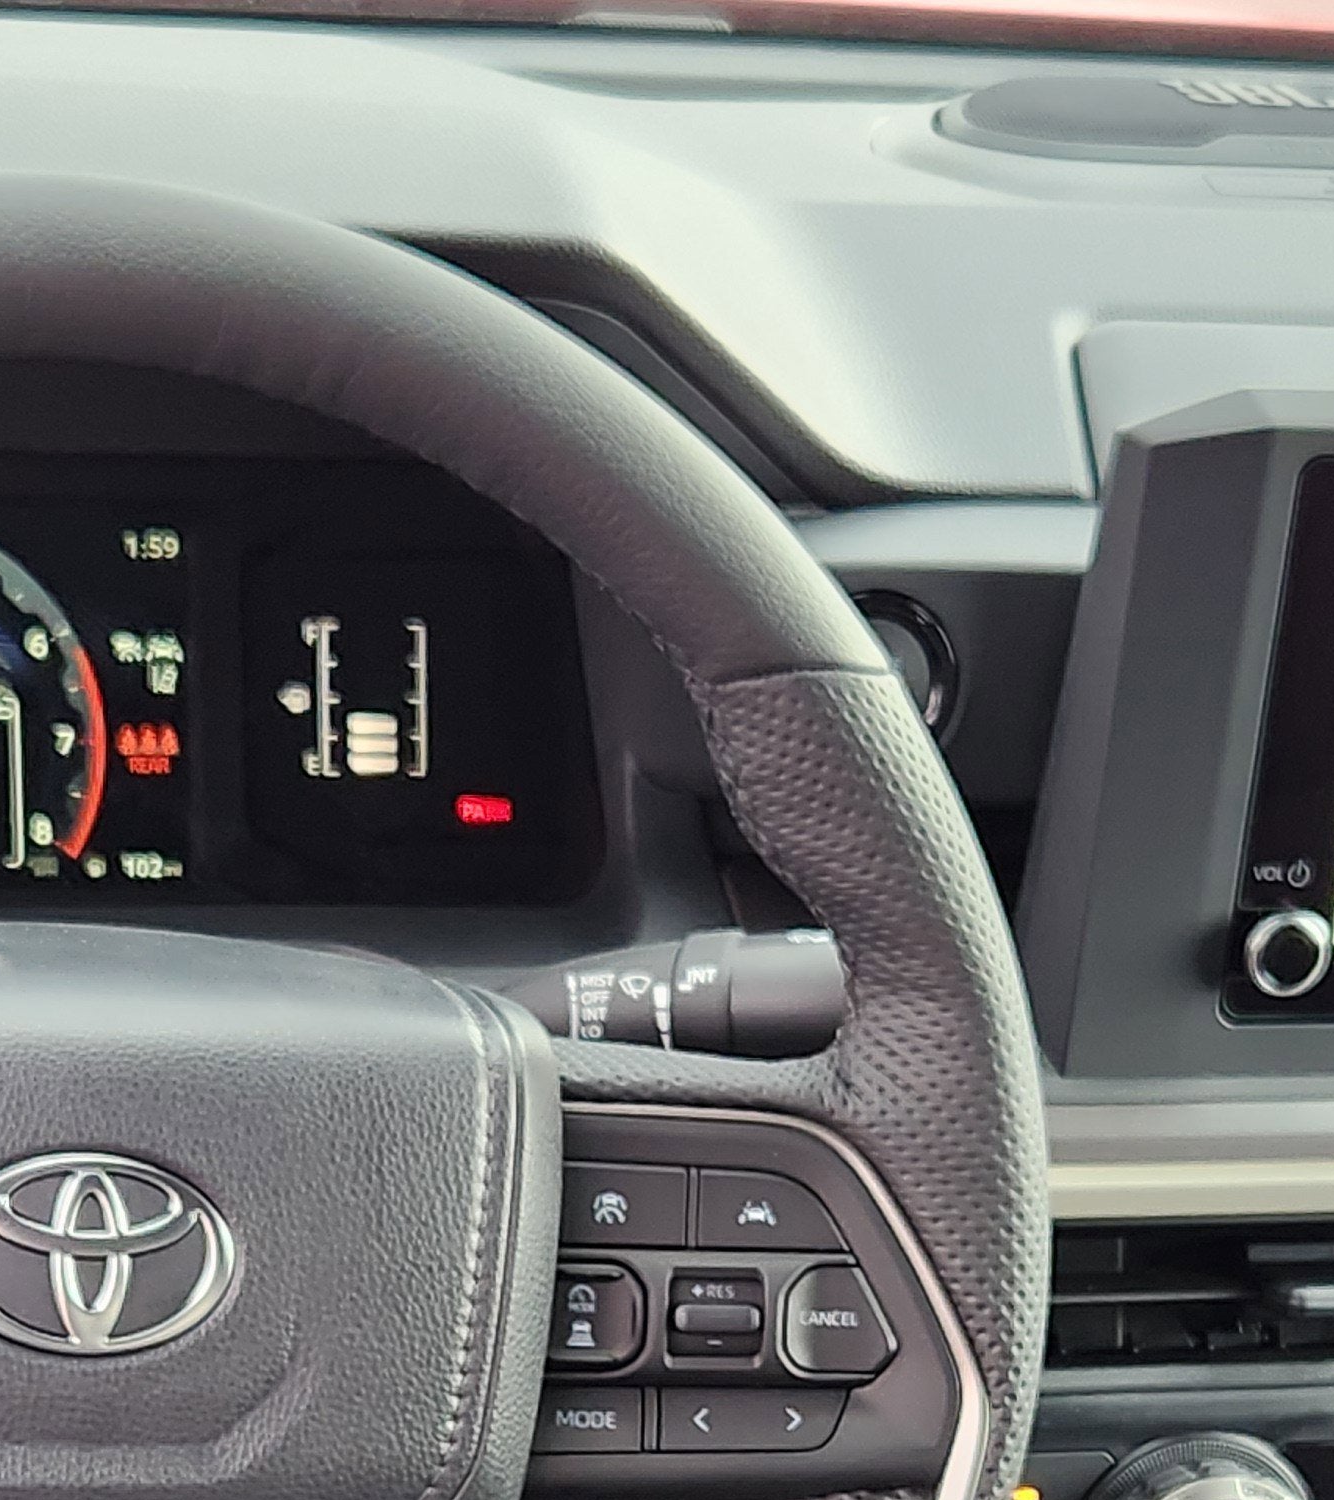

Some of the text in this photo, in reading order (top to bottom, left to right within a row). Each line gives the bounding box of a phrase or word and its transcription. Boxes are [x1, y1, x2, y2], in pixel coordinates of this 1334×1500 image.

[123, 529, 180, 560] 1:59
[23, 626, 49, 661] 6
[52, 721, 76, 757] 7
[28, 811, 54, 846] 8
[1252, 866, 1284, 882] VOL
[580, 973, 616, 989] MIST
[580, 990, 611, 1005] OFF
[580, 1006, 608, 1021] INT
[799, 1309, 859, 1328] CANCEL
[555, 1409, 618, 1430] MODE
